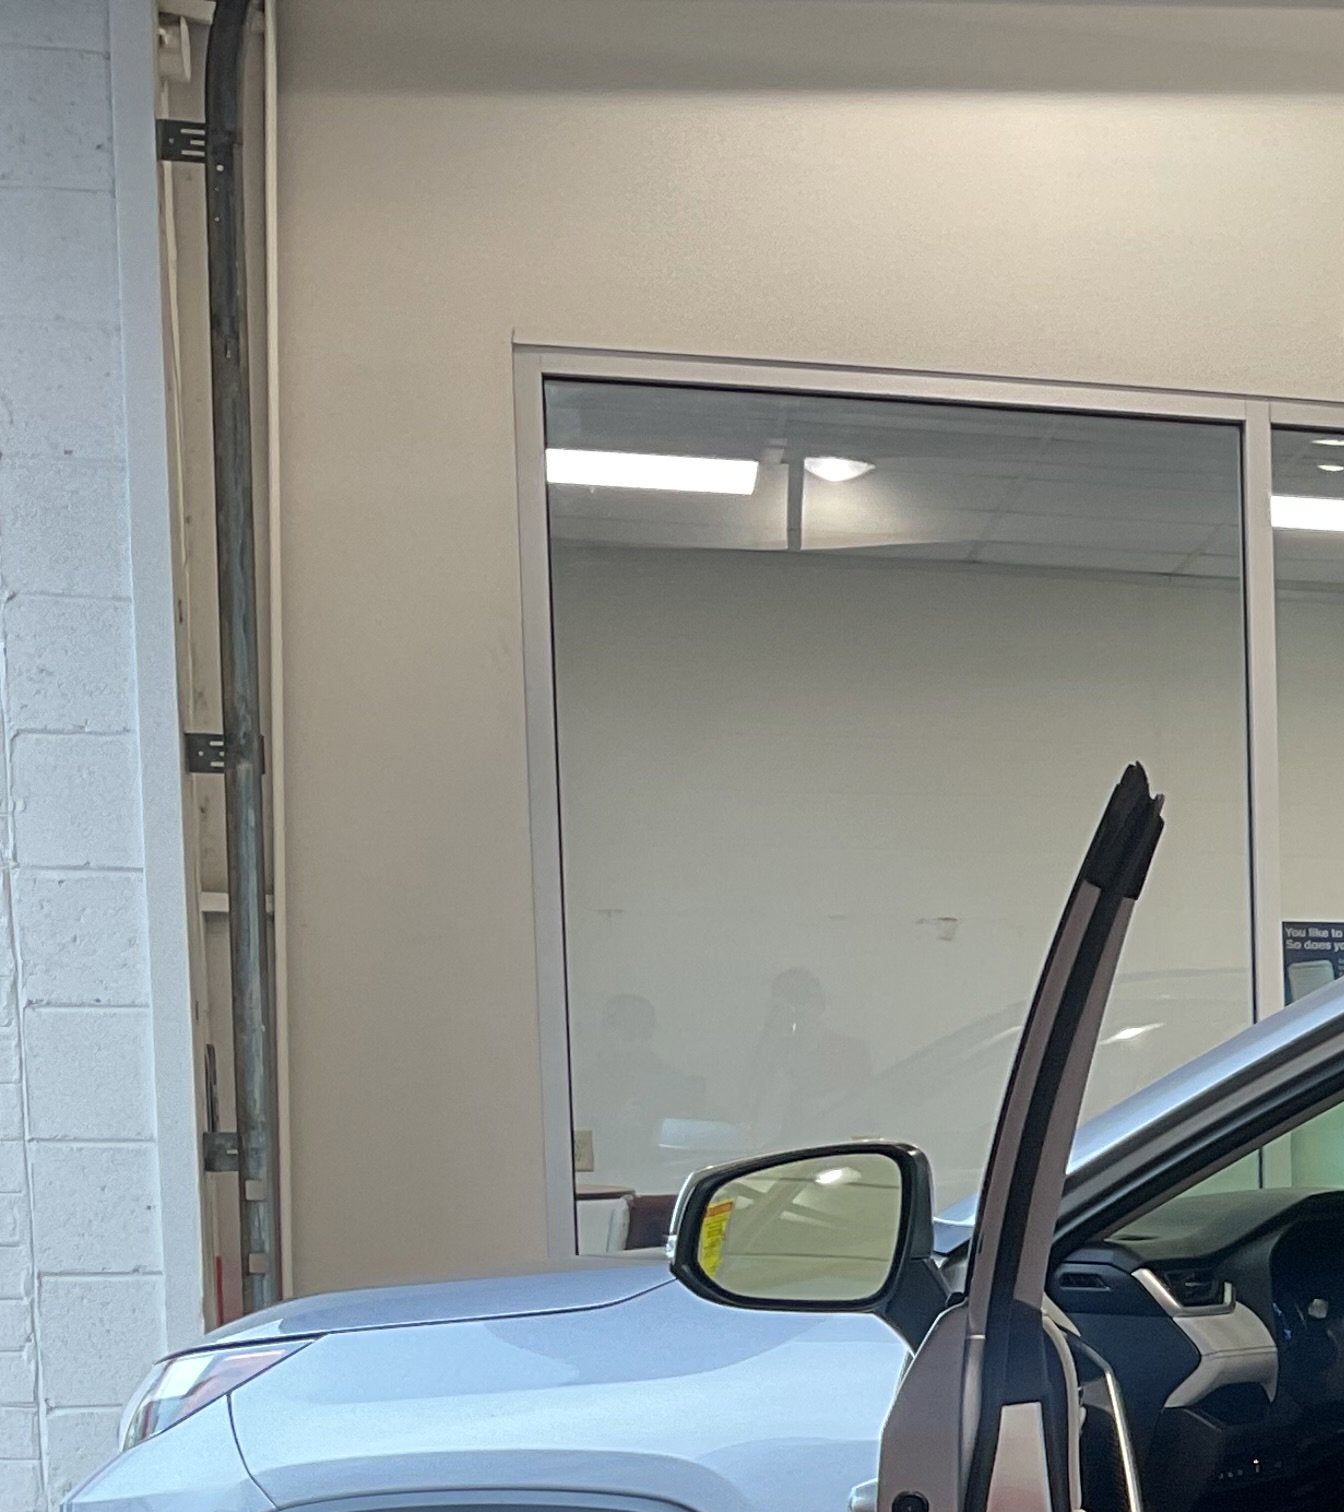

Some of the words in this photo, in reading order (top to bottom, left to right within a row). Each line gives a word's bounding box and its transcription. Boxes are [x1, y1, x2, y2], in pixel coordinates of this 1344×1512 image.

[1285, 927, 1306, 938] You
[1309, 927, 1329, 938] like
[1331, 928, 1343, 939] to
[1285, 939, 1302, 950] So
[1304, 939, 1332, 950] does
